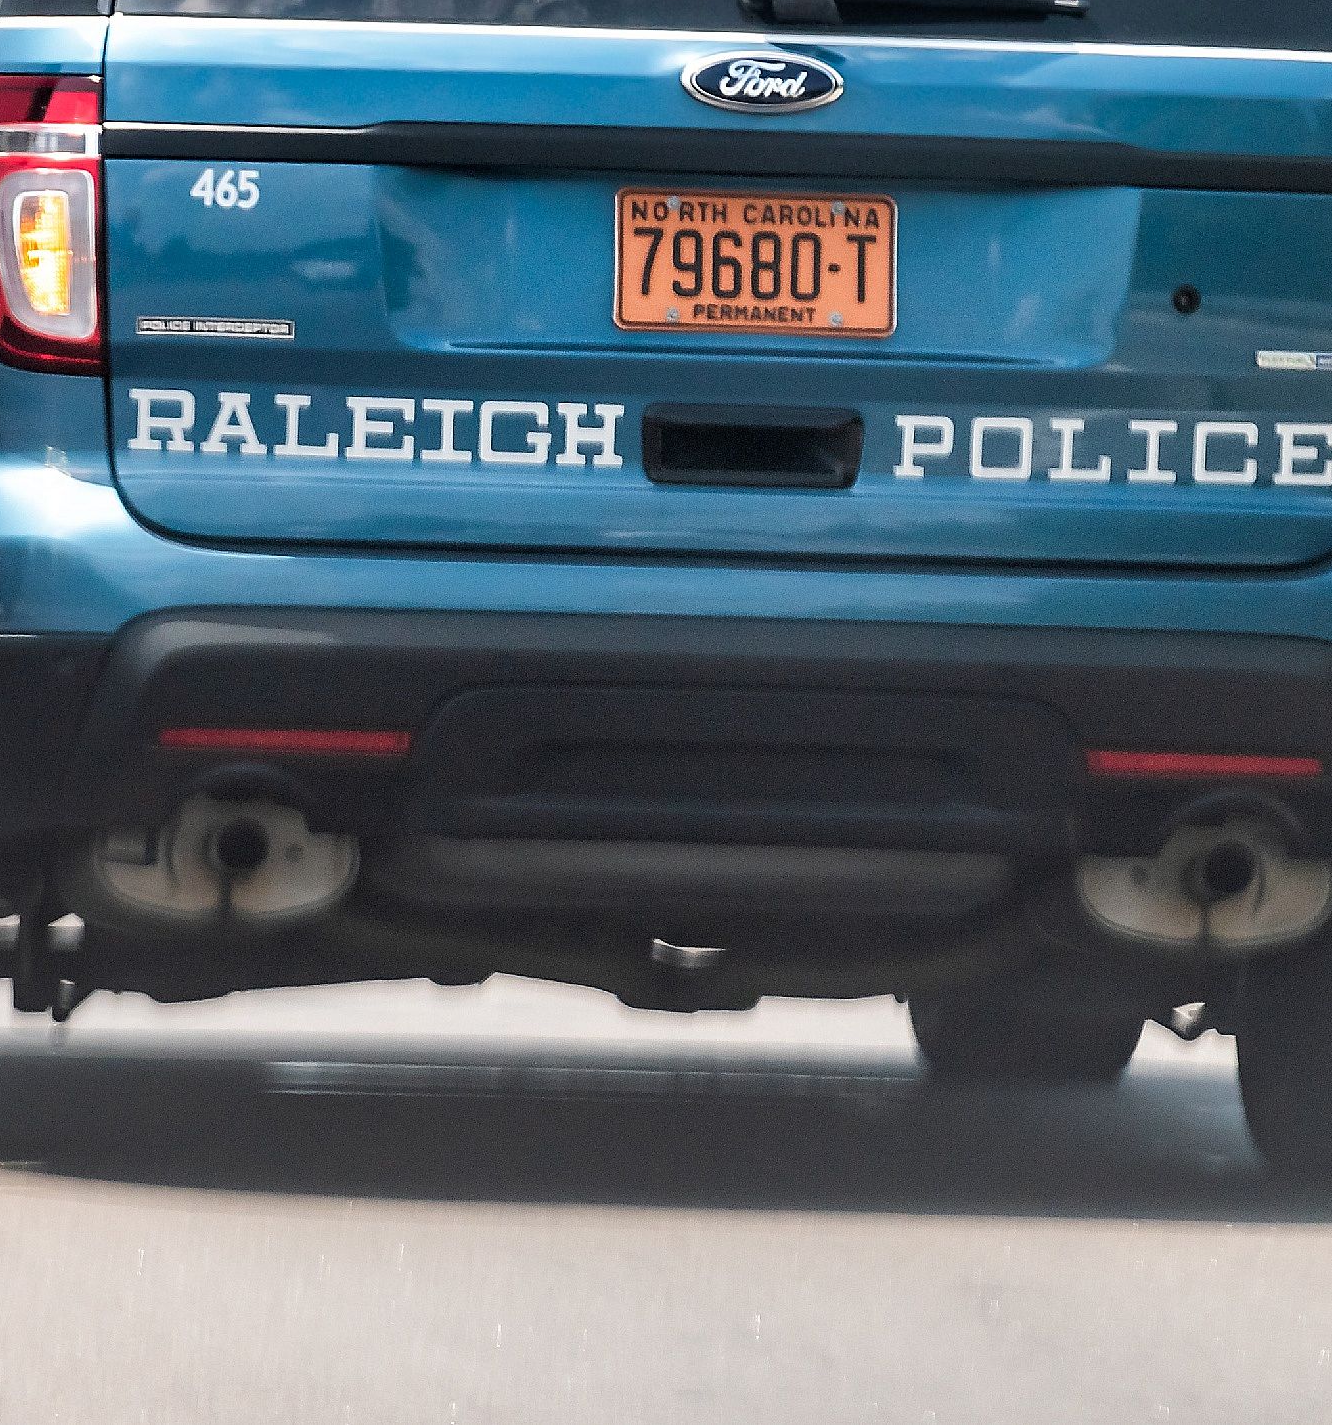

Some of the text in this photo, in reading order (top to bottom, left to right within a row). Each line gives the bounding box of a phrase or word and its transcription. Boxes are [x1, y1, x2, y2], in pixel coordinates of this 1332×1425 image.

[719, 59, 808, 98] Ford
[189, 168, 260, 209] 465
[631, 200, 880, 229] NORTH CAROLINA
[633, 226, 877, 304] 79680-T
[693, 303, 818, 323] PERMANENT
[127, 387, 625, 468] RALEIGH
